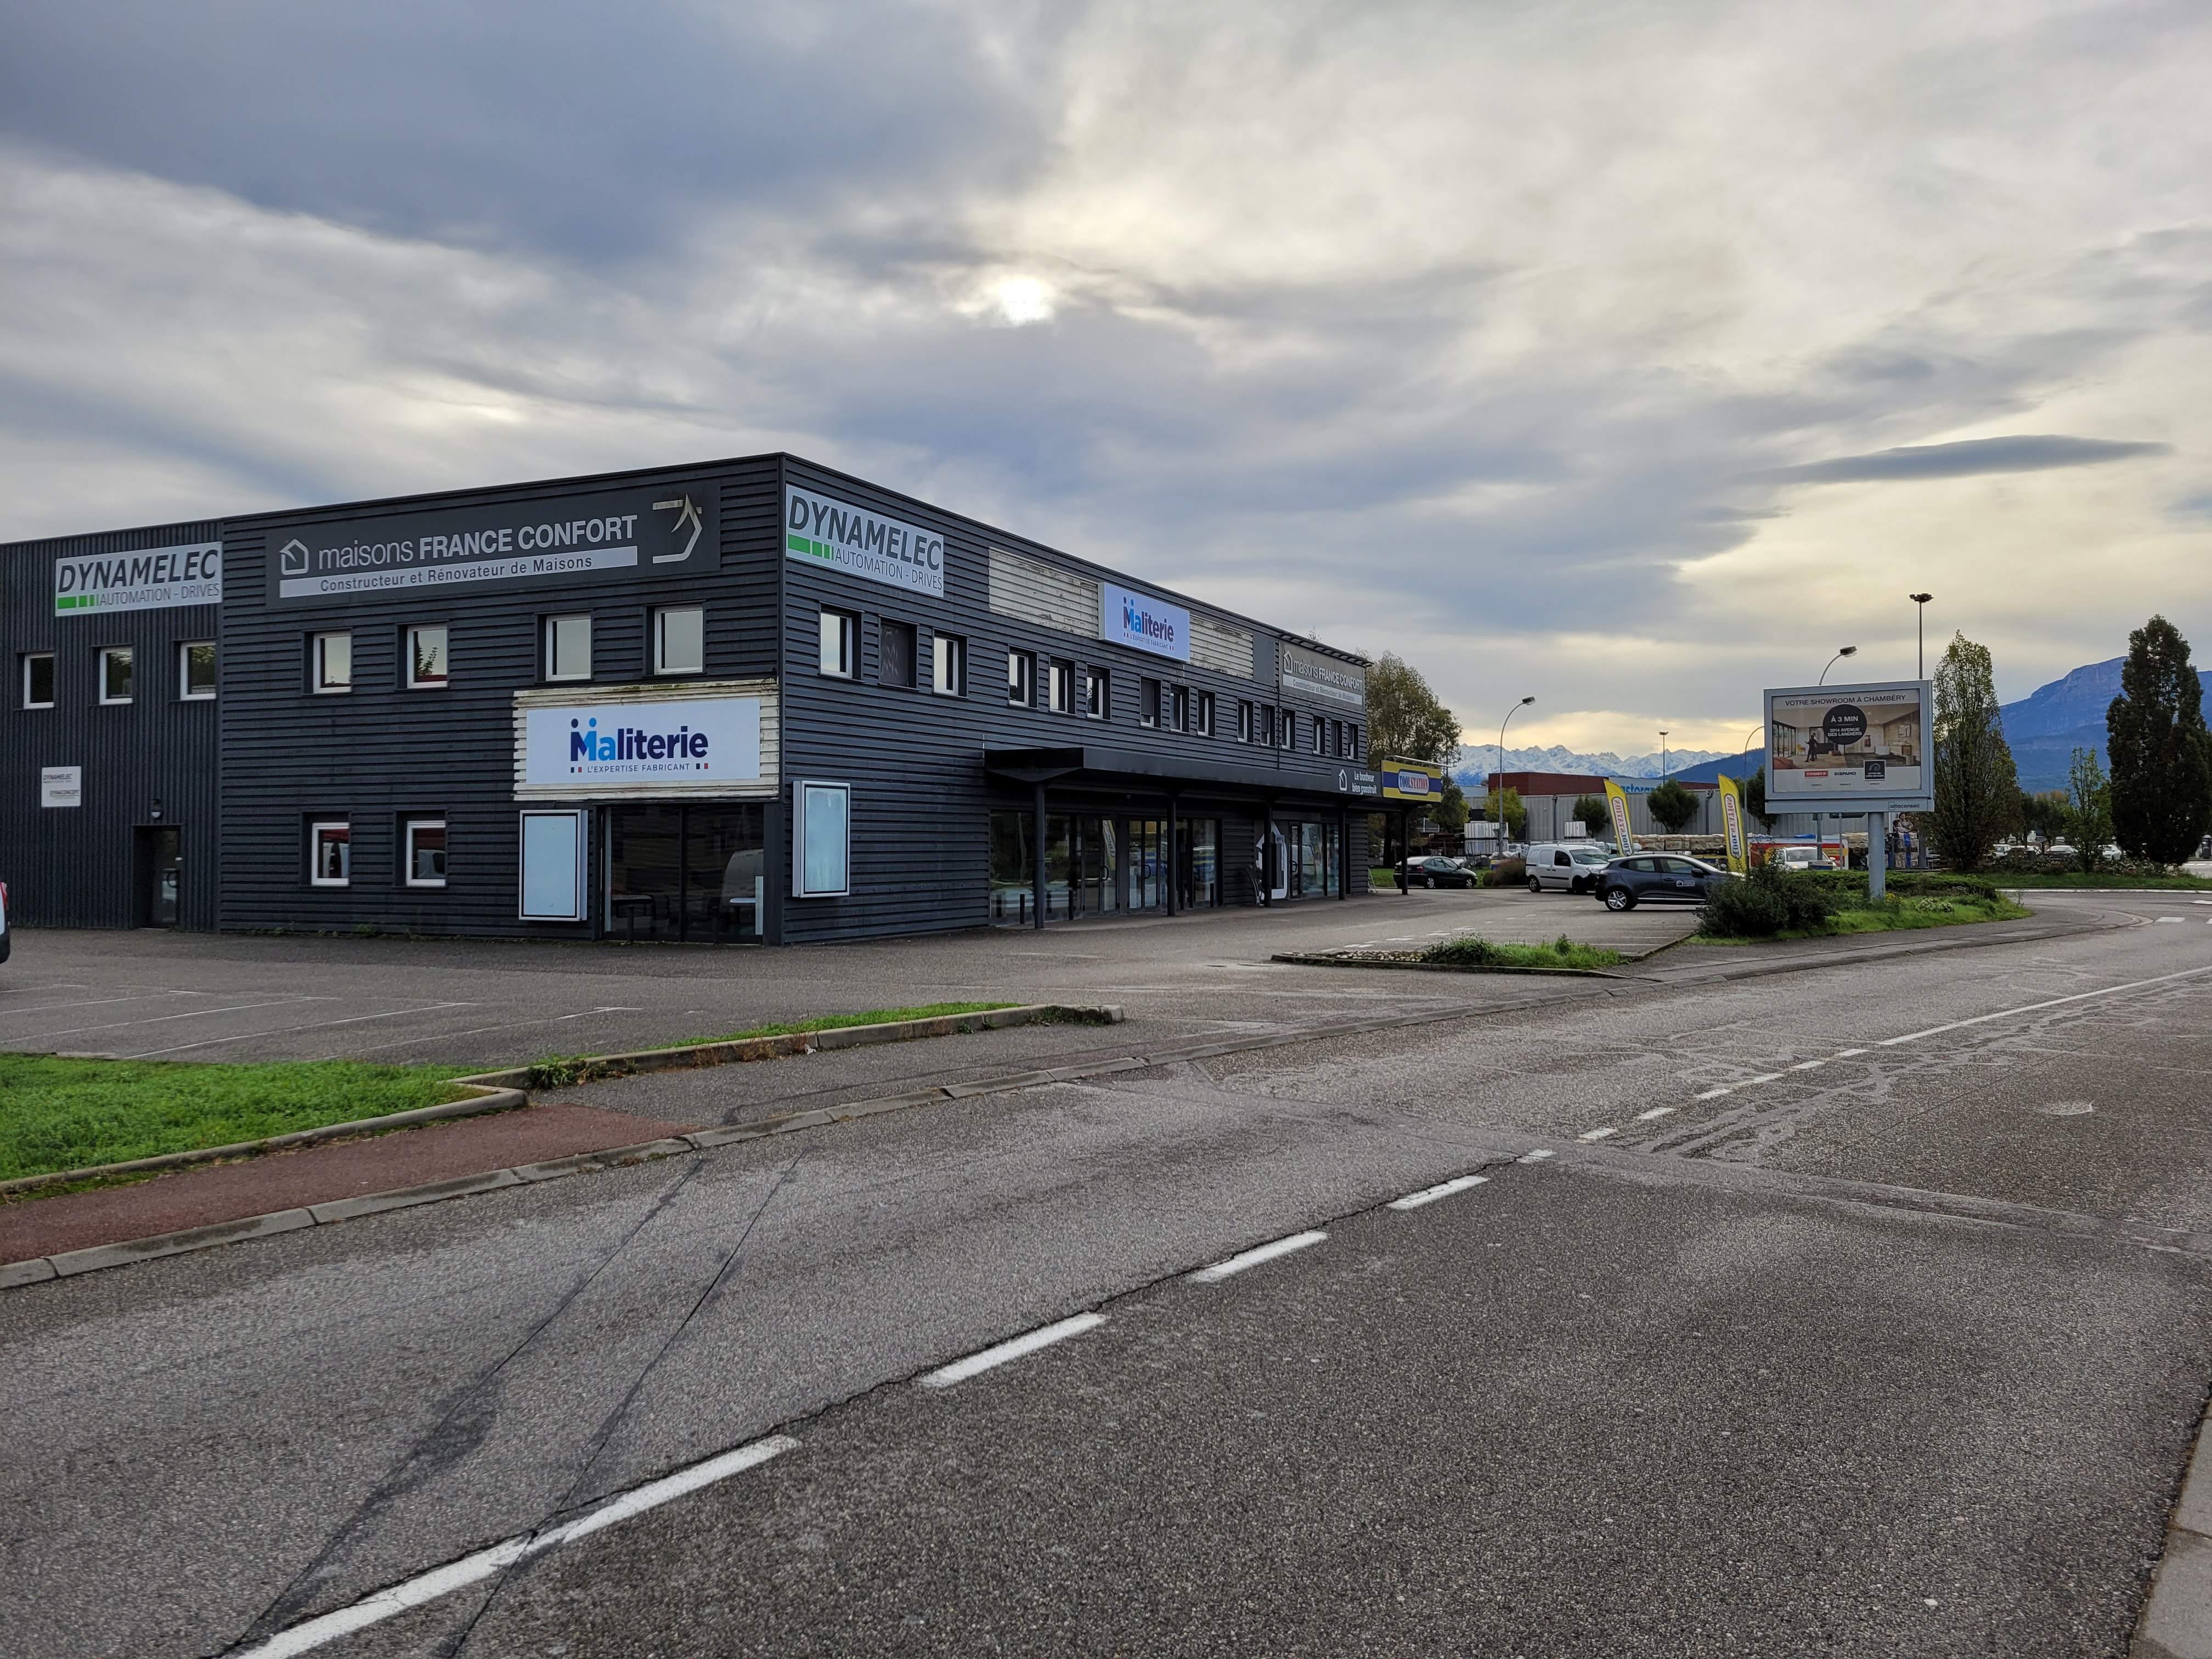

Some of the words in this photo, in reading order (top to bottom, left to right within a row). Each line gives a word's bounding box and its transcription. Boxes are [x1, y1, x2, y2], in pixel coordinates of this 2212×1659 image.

[319, 539, 414, 570] maisons
[419, 528, 513, 560] FRANCE
[518, 514, 638, 550] CONFORT
[788, 495, 941, 571] DYNAMELEC
[58, 549, 219, 593] DYNAMELEC
[320, 574, 405, 592] Constructeur
[410, 571, 422, 583] et
[428, 565, 505, 582] Rénovateur
[510, 561, 527, 574] de
[533, 557, 592, 572] Maisons
[834, 548, 902, 580] AUTOMATION
[912, 569, 943, 590] DRIVES
[99, 588, 171, 606] AUTOMATION
[181, 583, 220, 599] DRIVES
[1123, 596, 1174, 643] Maliterie
[1130, 634, 1150, 645] L'EXPERTISE
[1150, 640, 1168, 649] FABRICANT
[1293, 659, 1318, 679] maisons
[1319, 667, 1340, 685] FRANCE
[1339, 674, 1363, 691] CONFORT
[1810, 697, 1855, 705] SHOWROOM
[1864, 693, 1906, 703] CHAMBÉRY
[571, 718, 709, 761] Maliterie
[587, 765, 639, 773] L'EXPERTISE
[642, 763, 691, 772] FABRICANT
[1399, 775, 1428, 790] TOOLSTATION
